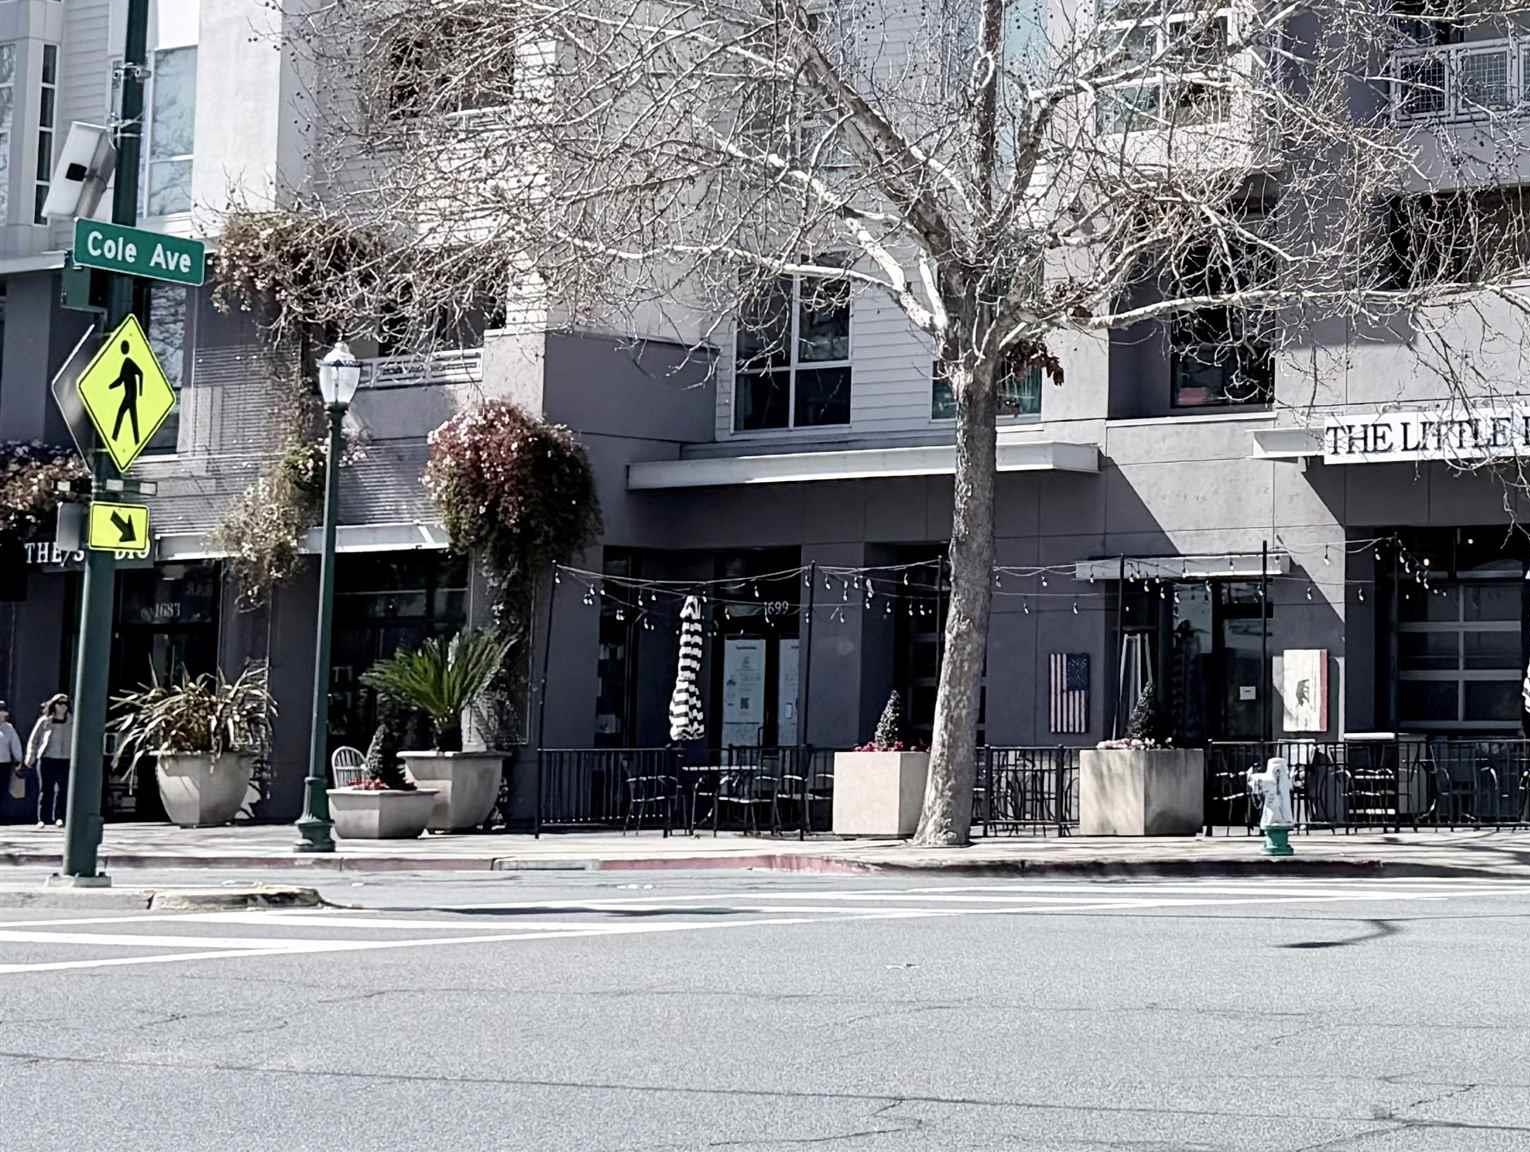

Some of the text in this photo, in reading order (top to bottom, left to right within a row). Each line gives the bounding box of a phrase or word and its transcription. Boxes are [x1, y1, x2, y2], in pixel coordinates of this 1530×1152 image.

[87, 230, 191, 273] Cole Ave
[1325, 422, 1393, 455] THE
[1400, 417, 1512, 453] LITTLE
[24, 542, 64, 564] THE
